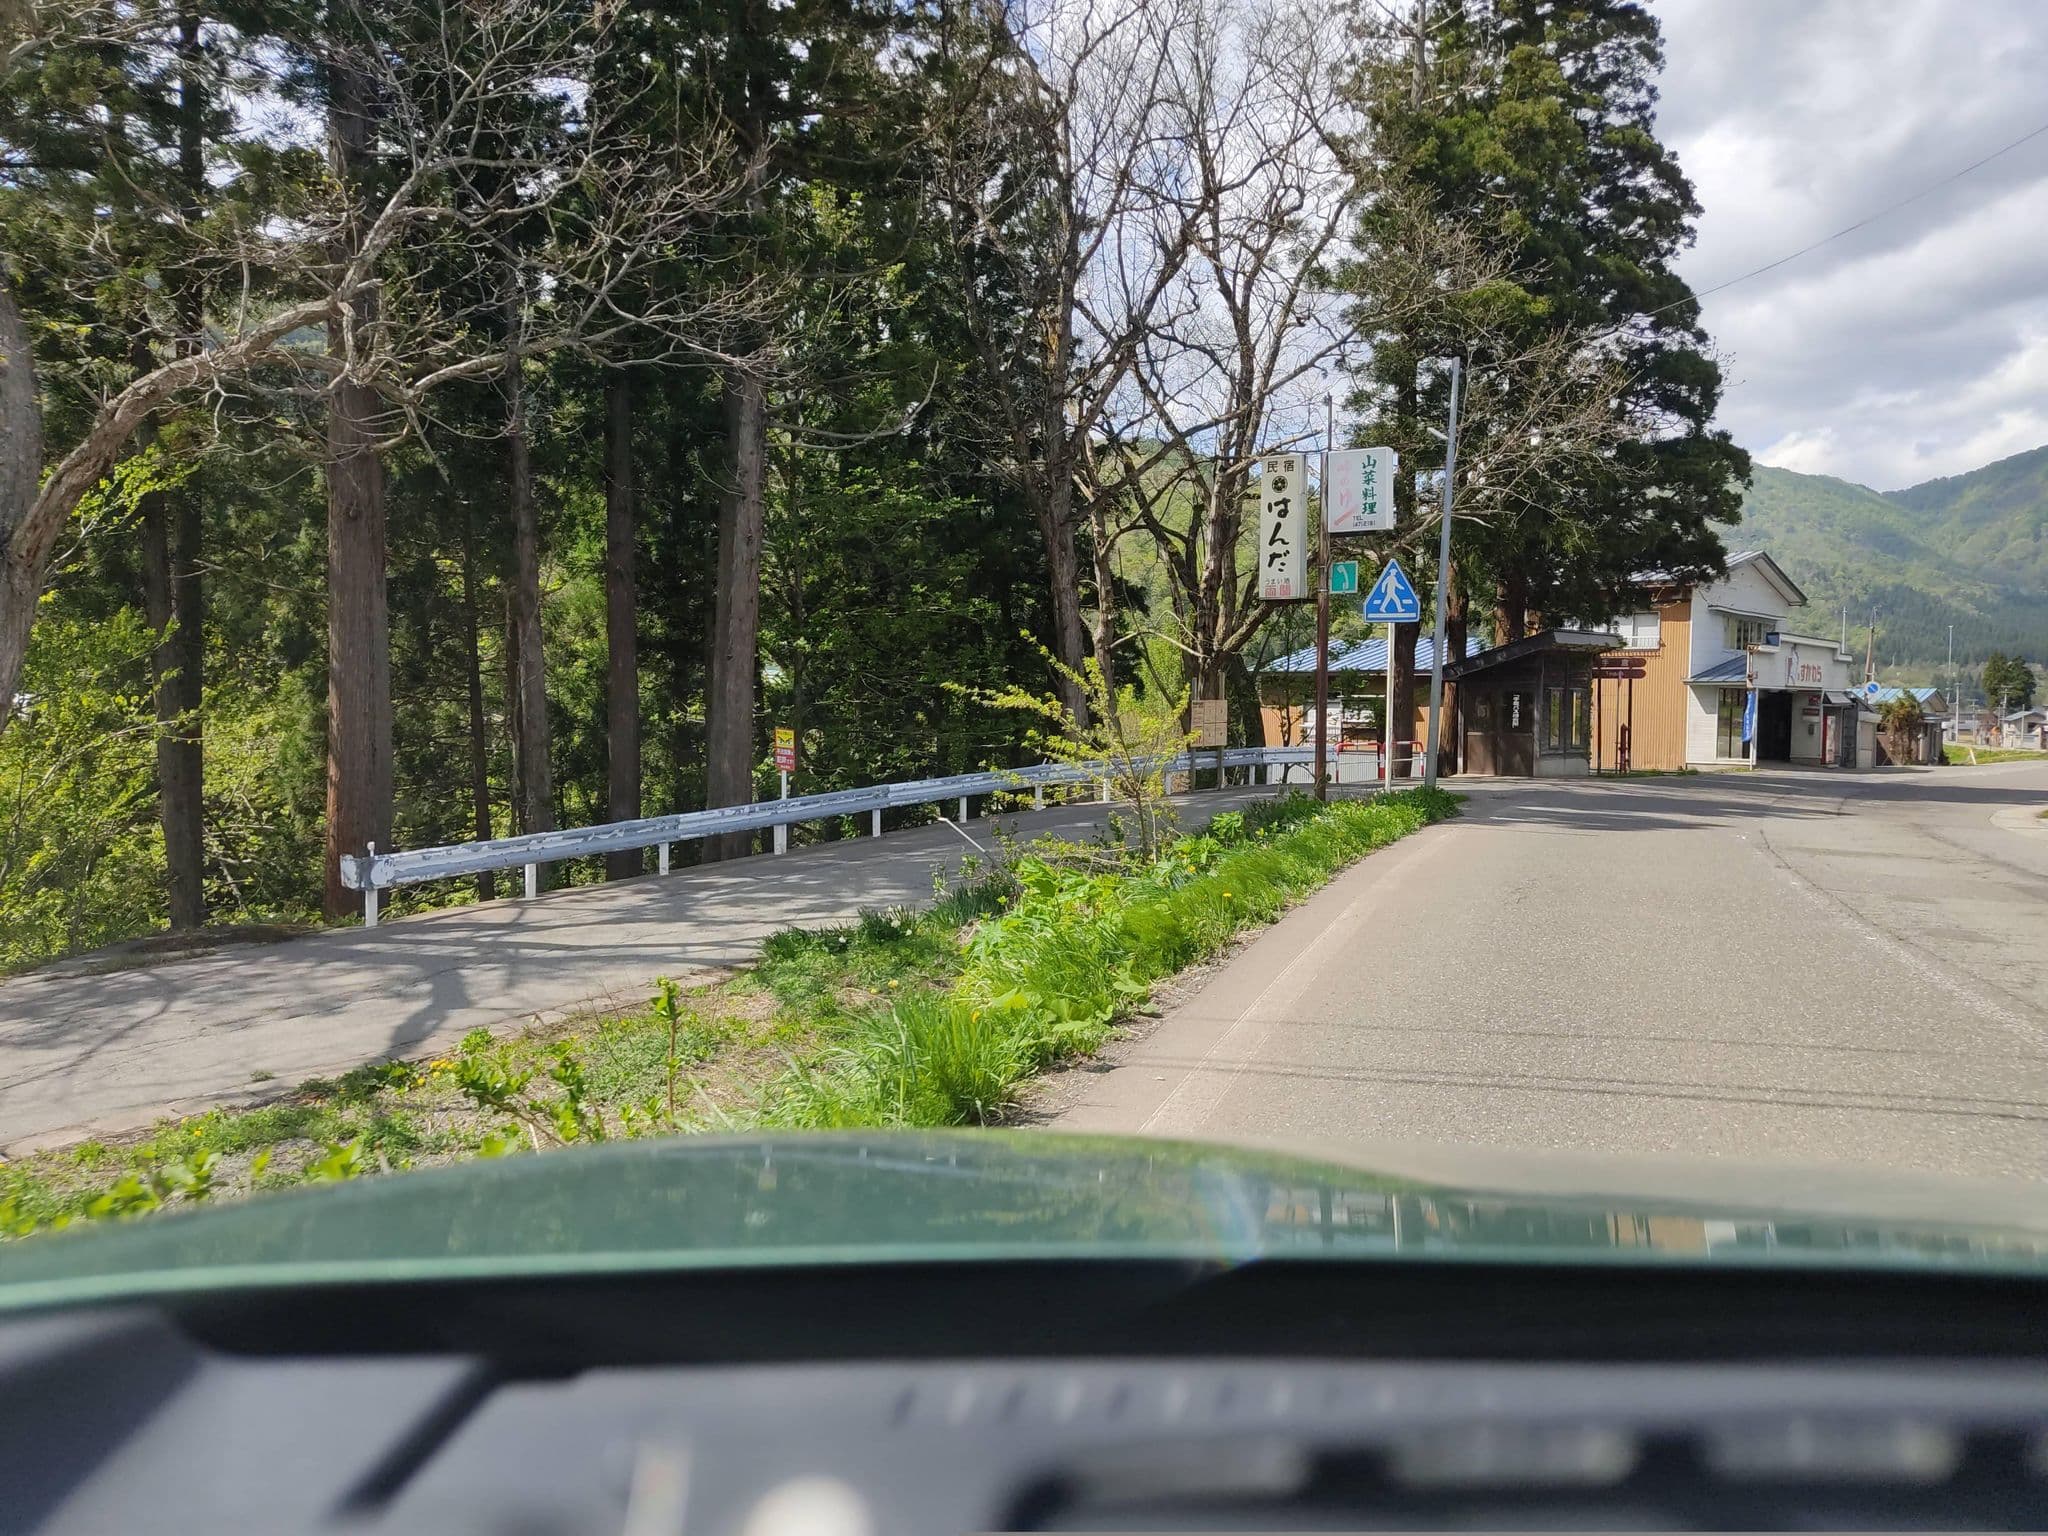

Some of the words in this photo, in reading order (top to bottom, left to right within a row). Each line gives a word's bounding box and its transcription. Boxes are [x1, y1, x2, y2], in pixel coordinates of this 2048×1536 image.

[1266, 460, 1295, 473] 民宿
[1361, 454, 1377, 515] 山菜料理
[1267, 497, 1292, 572] はんだ
